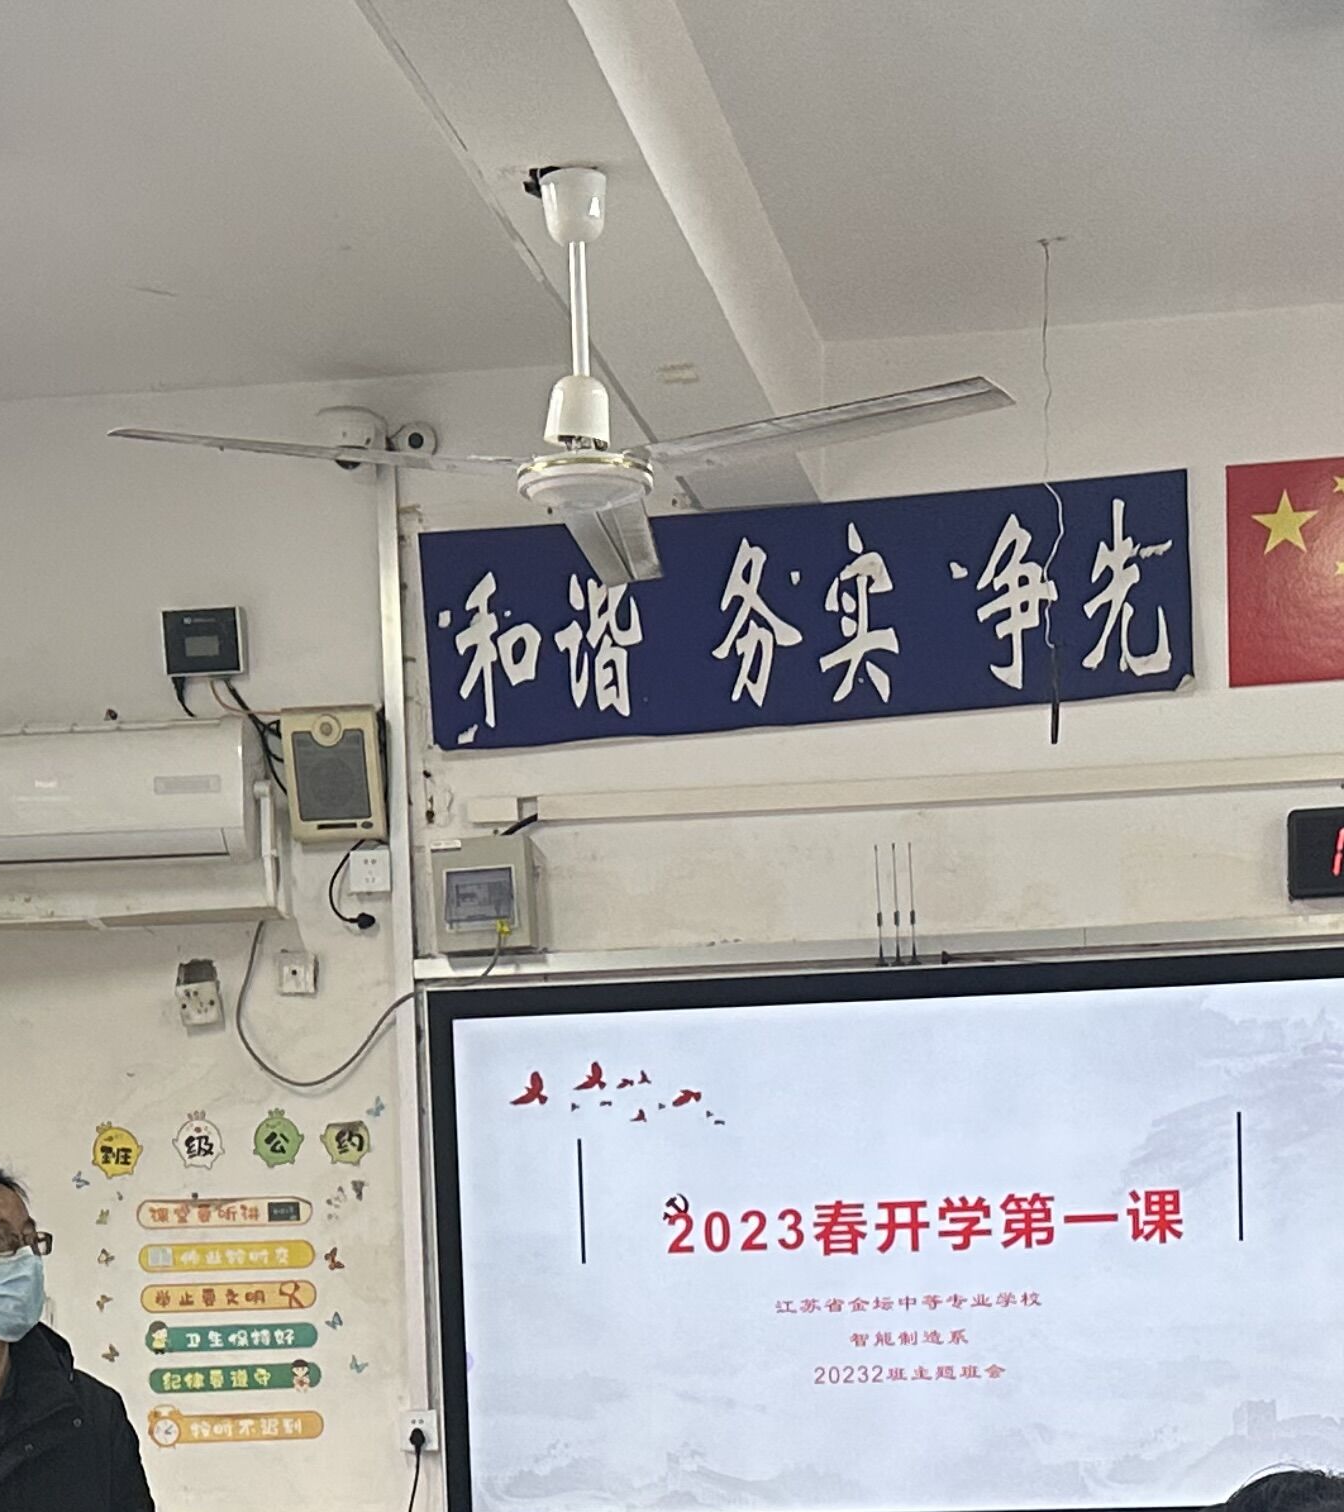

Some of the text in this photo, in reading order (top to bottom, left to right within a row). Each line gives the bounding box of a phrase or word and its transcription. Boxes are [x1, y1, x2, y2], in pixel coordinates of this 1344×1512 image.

[456, 497, 1174, 728] 和谐 务实 争先
[667, 1188, 1185, 1256] 2023春开学第一课
[774, 1291, 1044, 1314] 江苏省金坛中等专业学校
[185, 1327, 296, 1348] 卫生保持好
[849, 1327, 970, 1348] 智能制造系
[162, 1367, 272, 1391] 纪律要遵守
[813, 1363, 1007, 1386] 20232班主题班会
